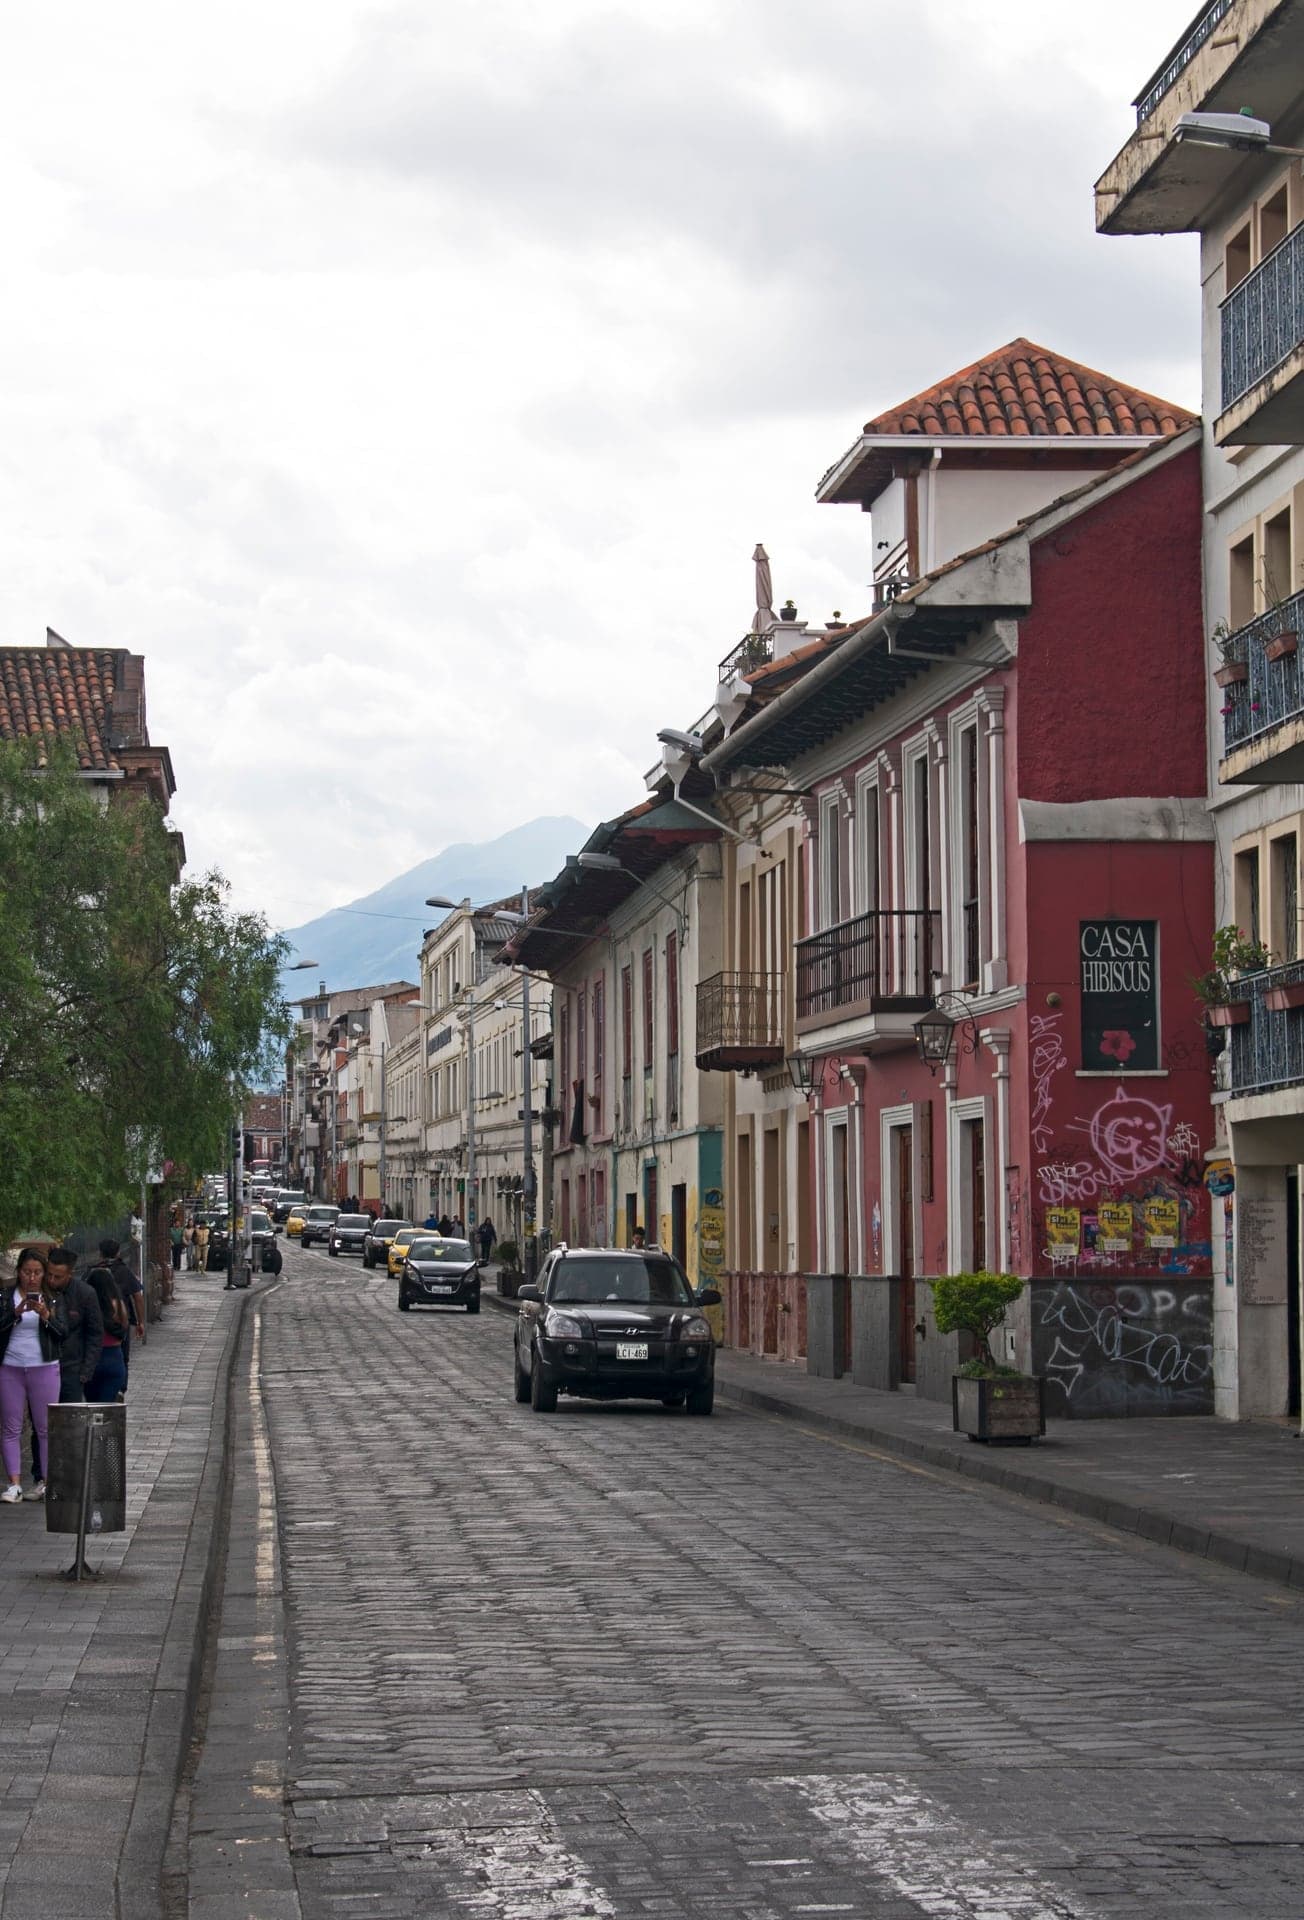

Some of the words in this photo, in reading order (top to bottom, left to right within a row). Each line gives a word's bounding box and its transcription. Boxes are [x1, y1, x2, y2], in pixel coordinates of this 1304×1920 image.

[1081, 926, 1149, 957] CASA
[1082, 961, 1150, 993] HIBISCUS
[617, 1349, 647, 1358] LCI-469
